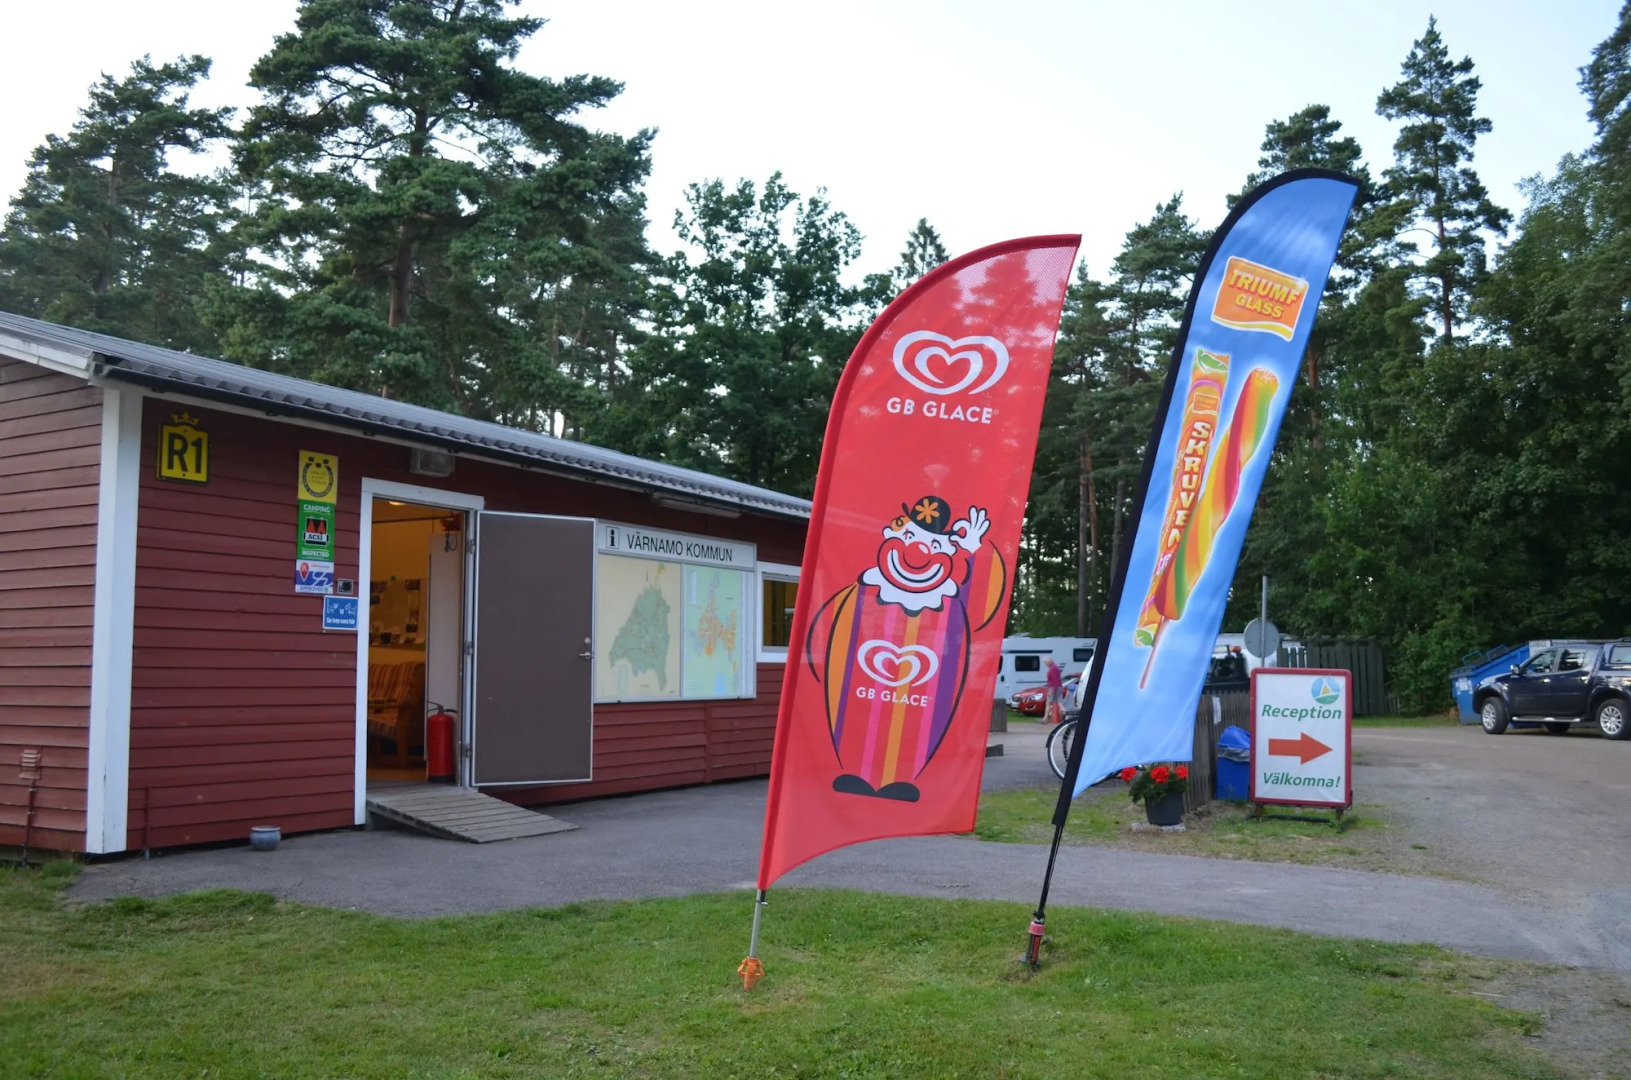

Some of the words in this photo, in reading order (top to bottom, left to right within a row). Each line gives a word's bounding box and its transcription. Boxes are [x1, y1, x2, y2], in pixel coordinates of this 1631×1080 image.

[1229, 269, 1301, 306] TRIUMF
[1235, 293, 1284, 319] GLASS
[886, 397, 915, 415] GB
[922, 400, 993, 424] GLACE
[167, 432, 203, 475] R1
[303, 504, 331, 513] CAMPING
[301, 550, 330, 558] INSPECTED
[626, 531, 684, 556] VÄRNAMO
[686, 542, 733, 562] KOMMUN
[856, 686, 876, 700] GB
[881, 690, 929, 707] GLACE
[1261, 704, 1342, 721] Reception
[1262, 772, 1342, 788] Välkomna!
